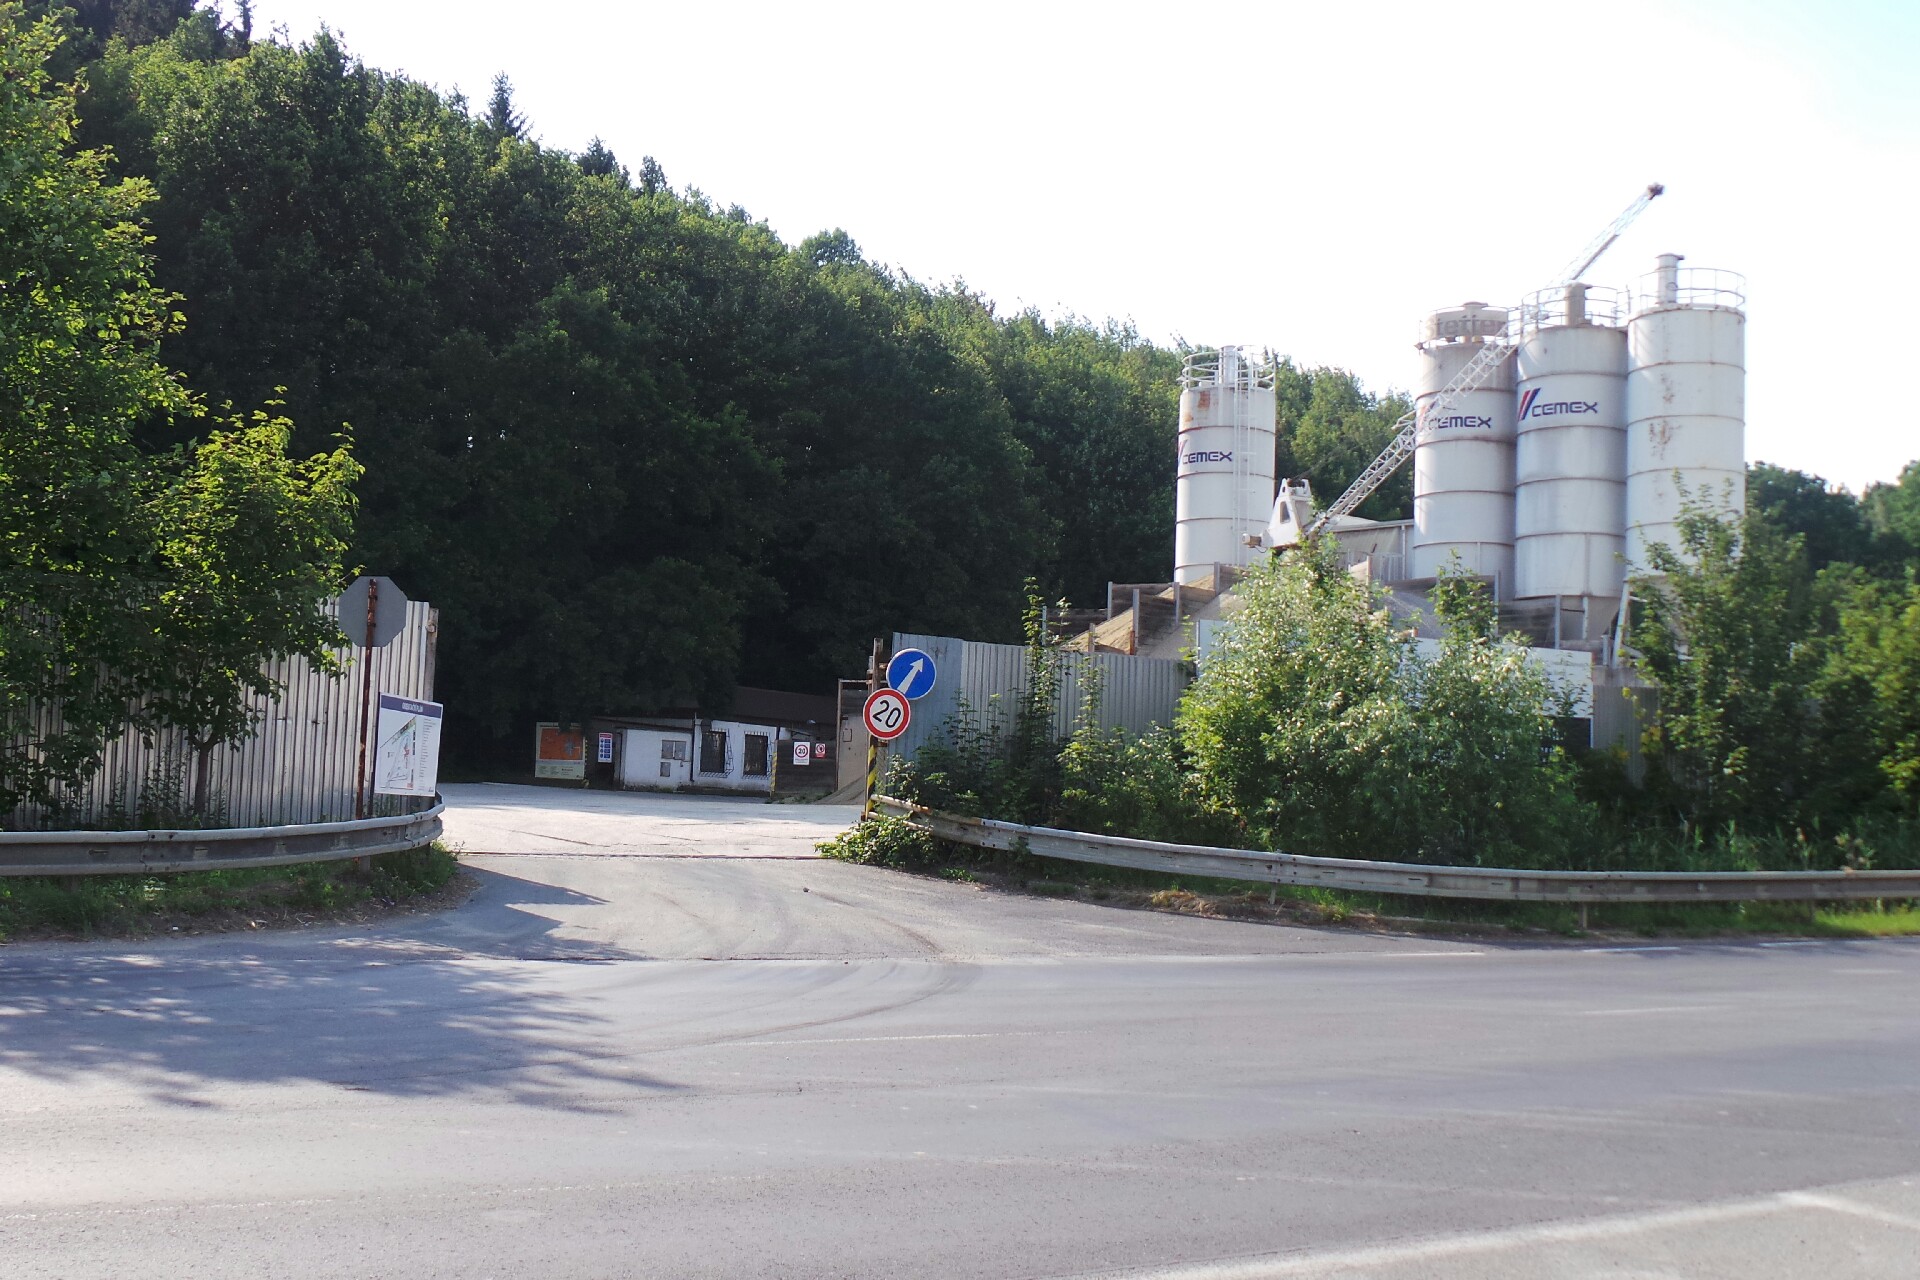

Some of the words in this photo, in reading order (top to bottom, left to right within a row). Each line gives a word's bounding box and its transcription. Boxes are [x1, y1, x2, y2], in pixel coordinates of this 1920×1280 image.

[1531, 402, 1598, 417] CEMEX
[1183, 451, 1232, 464] CEMEX
[872, 699, 902, 728] 20
[798, 747, 806, 755] 20
